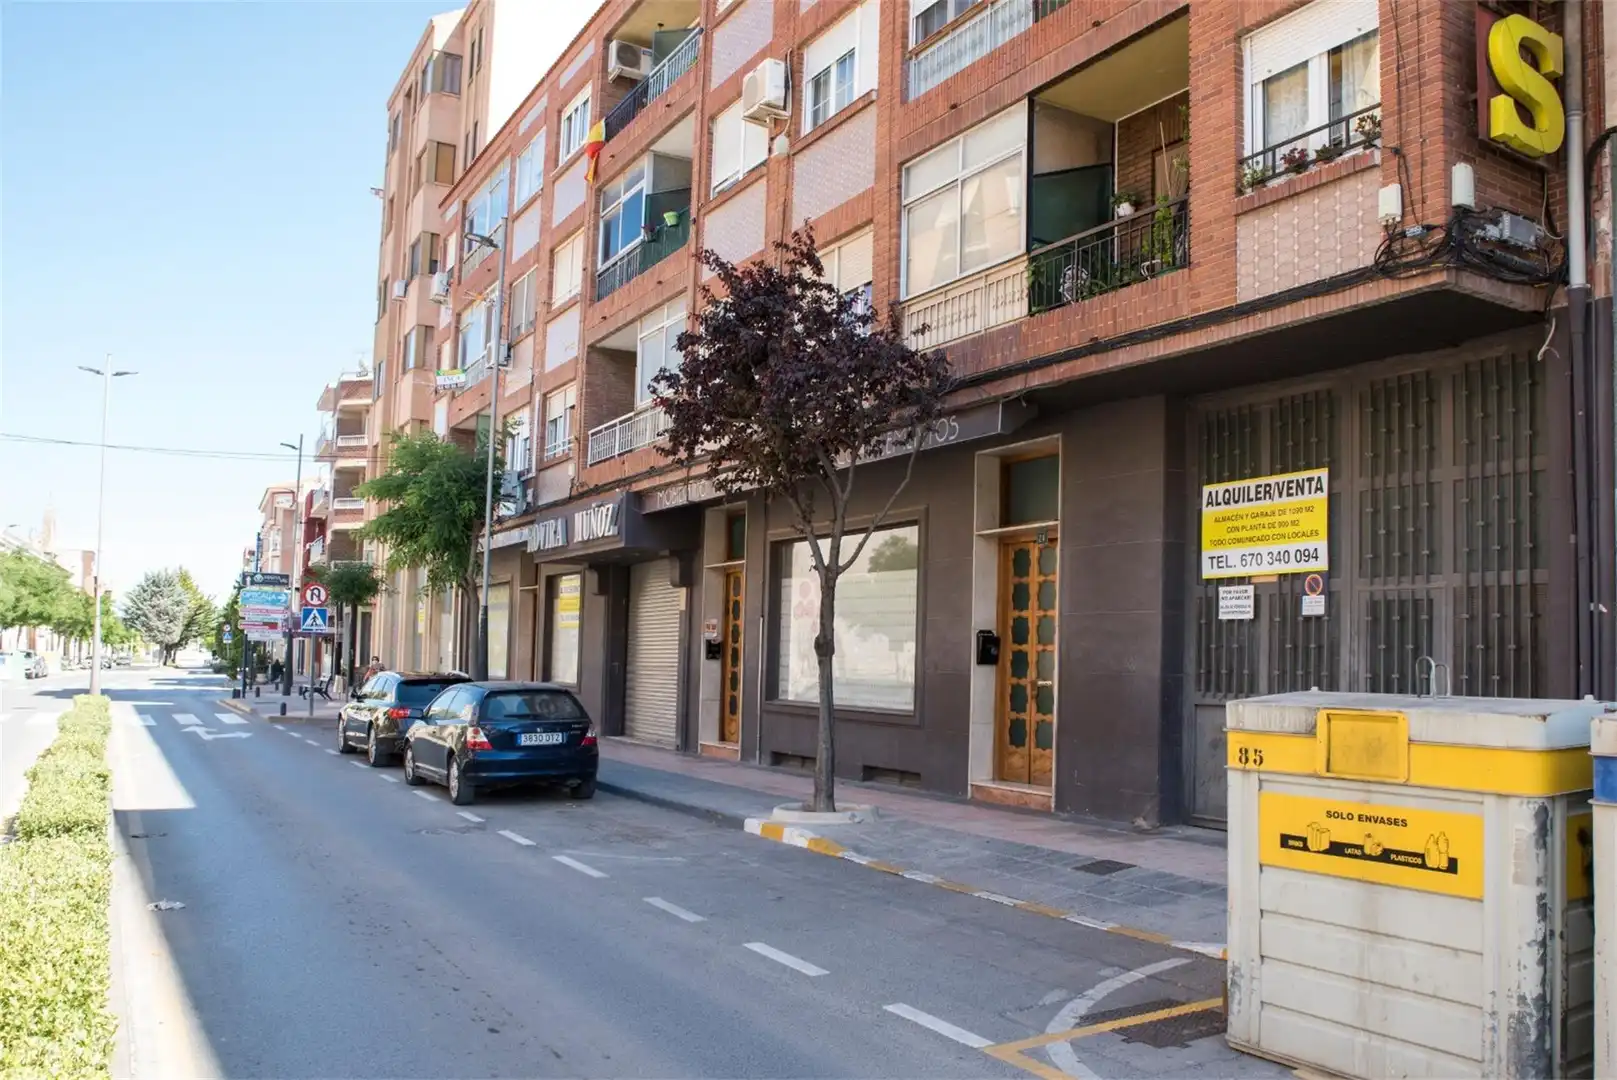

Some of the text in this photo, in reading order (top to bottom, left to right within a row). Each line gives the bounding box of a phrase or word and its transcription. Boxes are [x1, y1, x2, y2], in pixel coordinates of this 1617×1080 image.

[1488, 14, 1565, 158] S
[1206, 475, 1324, 507] ALQUILER/VENTA
[1214, 511, 1244, 523] ALMACÉN
[1250, 508, 1276, 519] GARAJE
[1278, 508, 1286, 516] DE
[527, 517, 566, 553] ROVIRA
[574, 501, 616, 543] MUÑOZ
[1227, 526, 1240, 534] CON
[1241, 522, 1265, 532] PLANTA
[1267, 521, 1276, 529] DE
[1209, 529, 1319, 546] TODO COMUNICADO CON LOCALES
[1208, 547, 1319, 569] TEL. 670 340 094
[1326, 810, 1408, 828] SOLO ENVASES
[1344, 847, 1361, 856] LATAS
